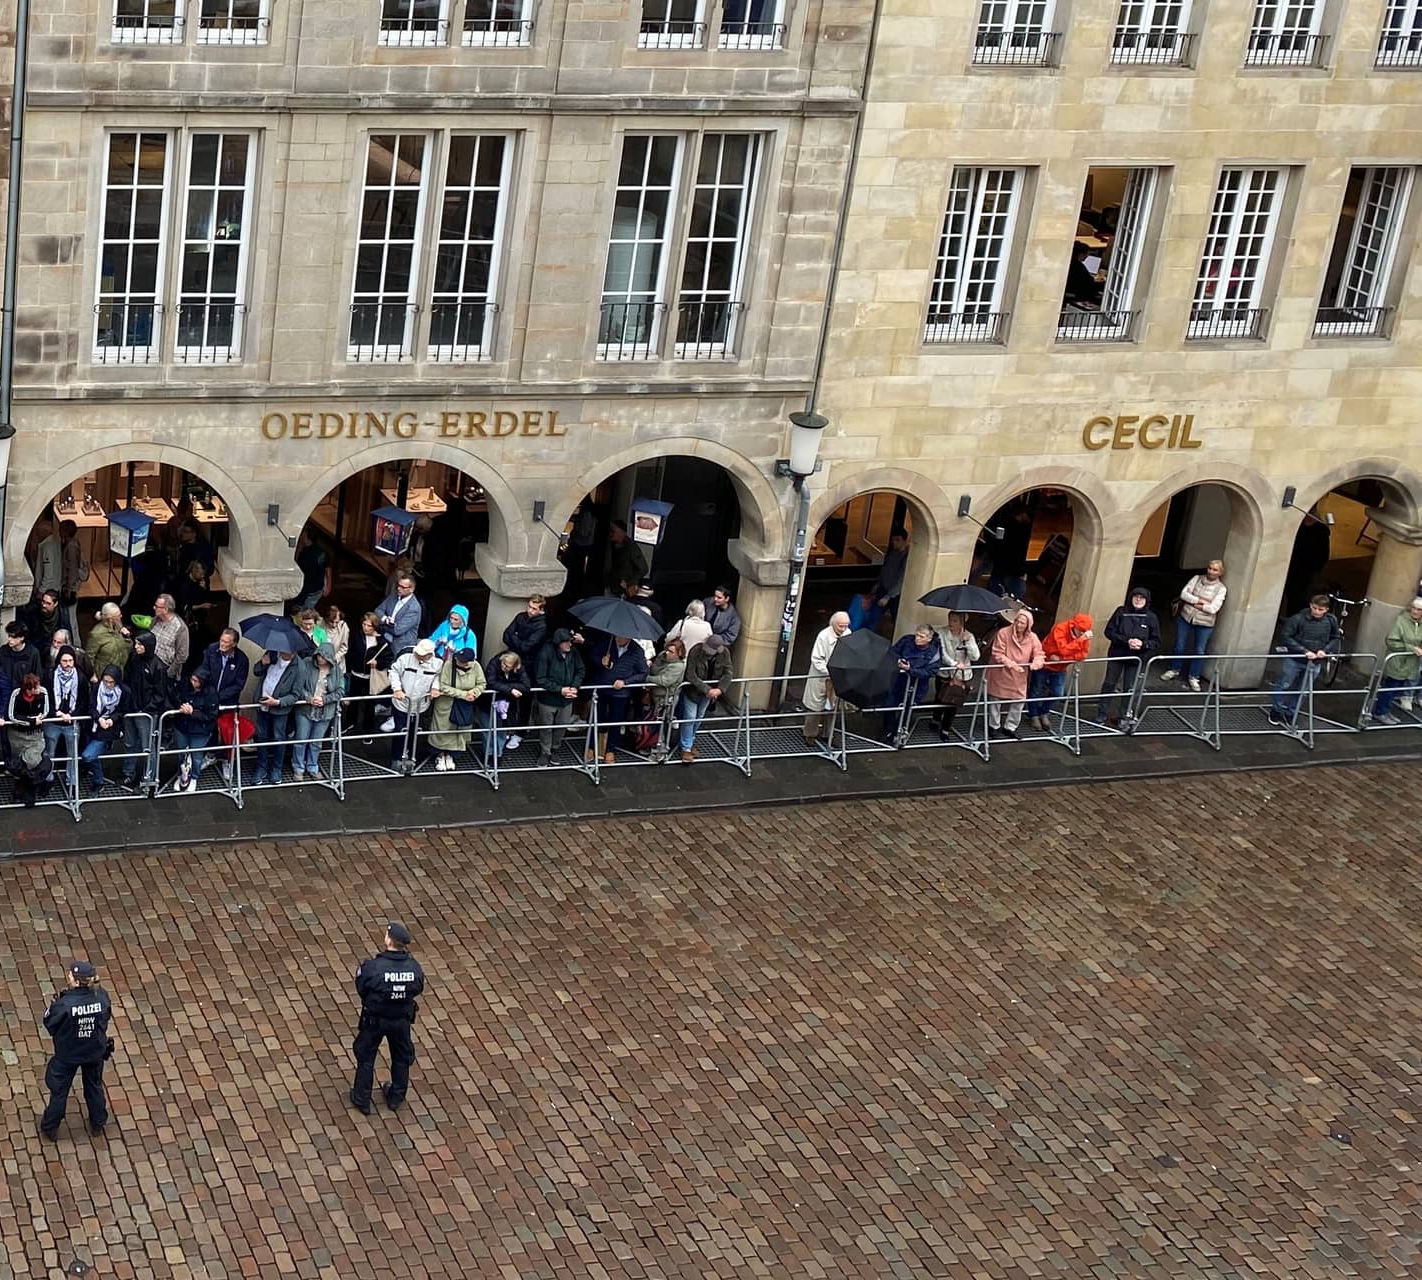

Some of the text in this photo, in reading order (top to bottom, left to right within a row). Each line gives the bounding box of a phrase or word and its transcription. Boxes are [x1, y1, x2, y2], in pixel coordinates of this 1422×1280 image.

[261, 410, 568, 440] OEDING-ERDEL
[1082, 414, 1203, 451] CECIL
[384, 972, 415, 983] POLIZEI
[71, 1002, 102, 1017] POLIZEI
[78, 1016, 96, 1025] NRW
